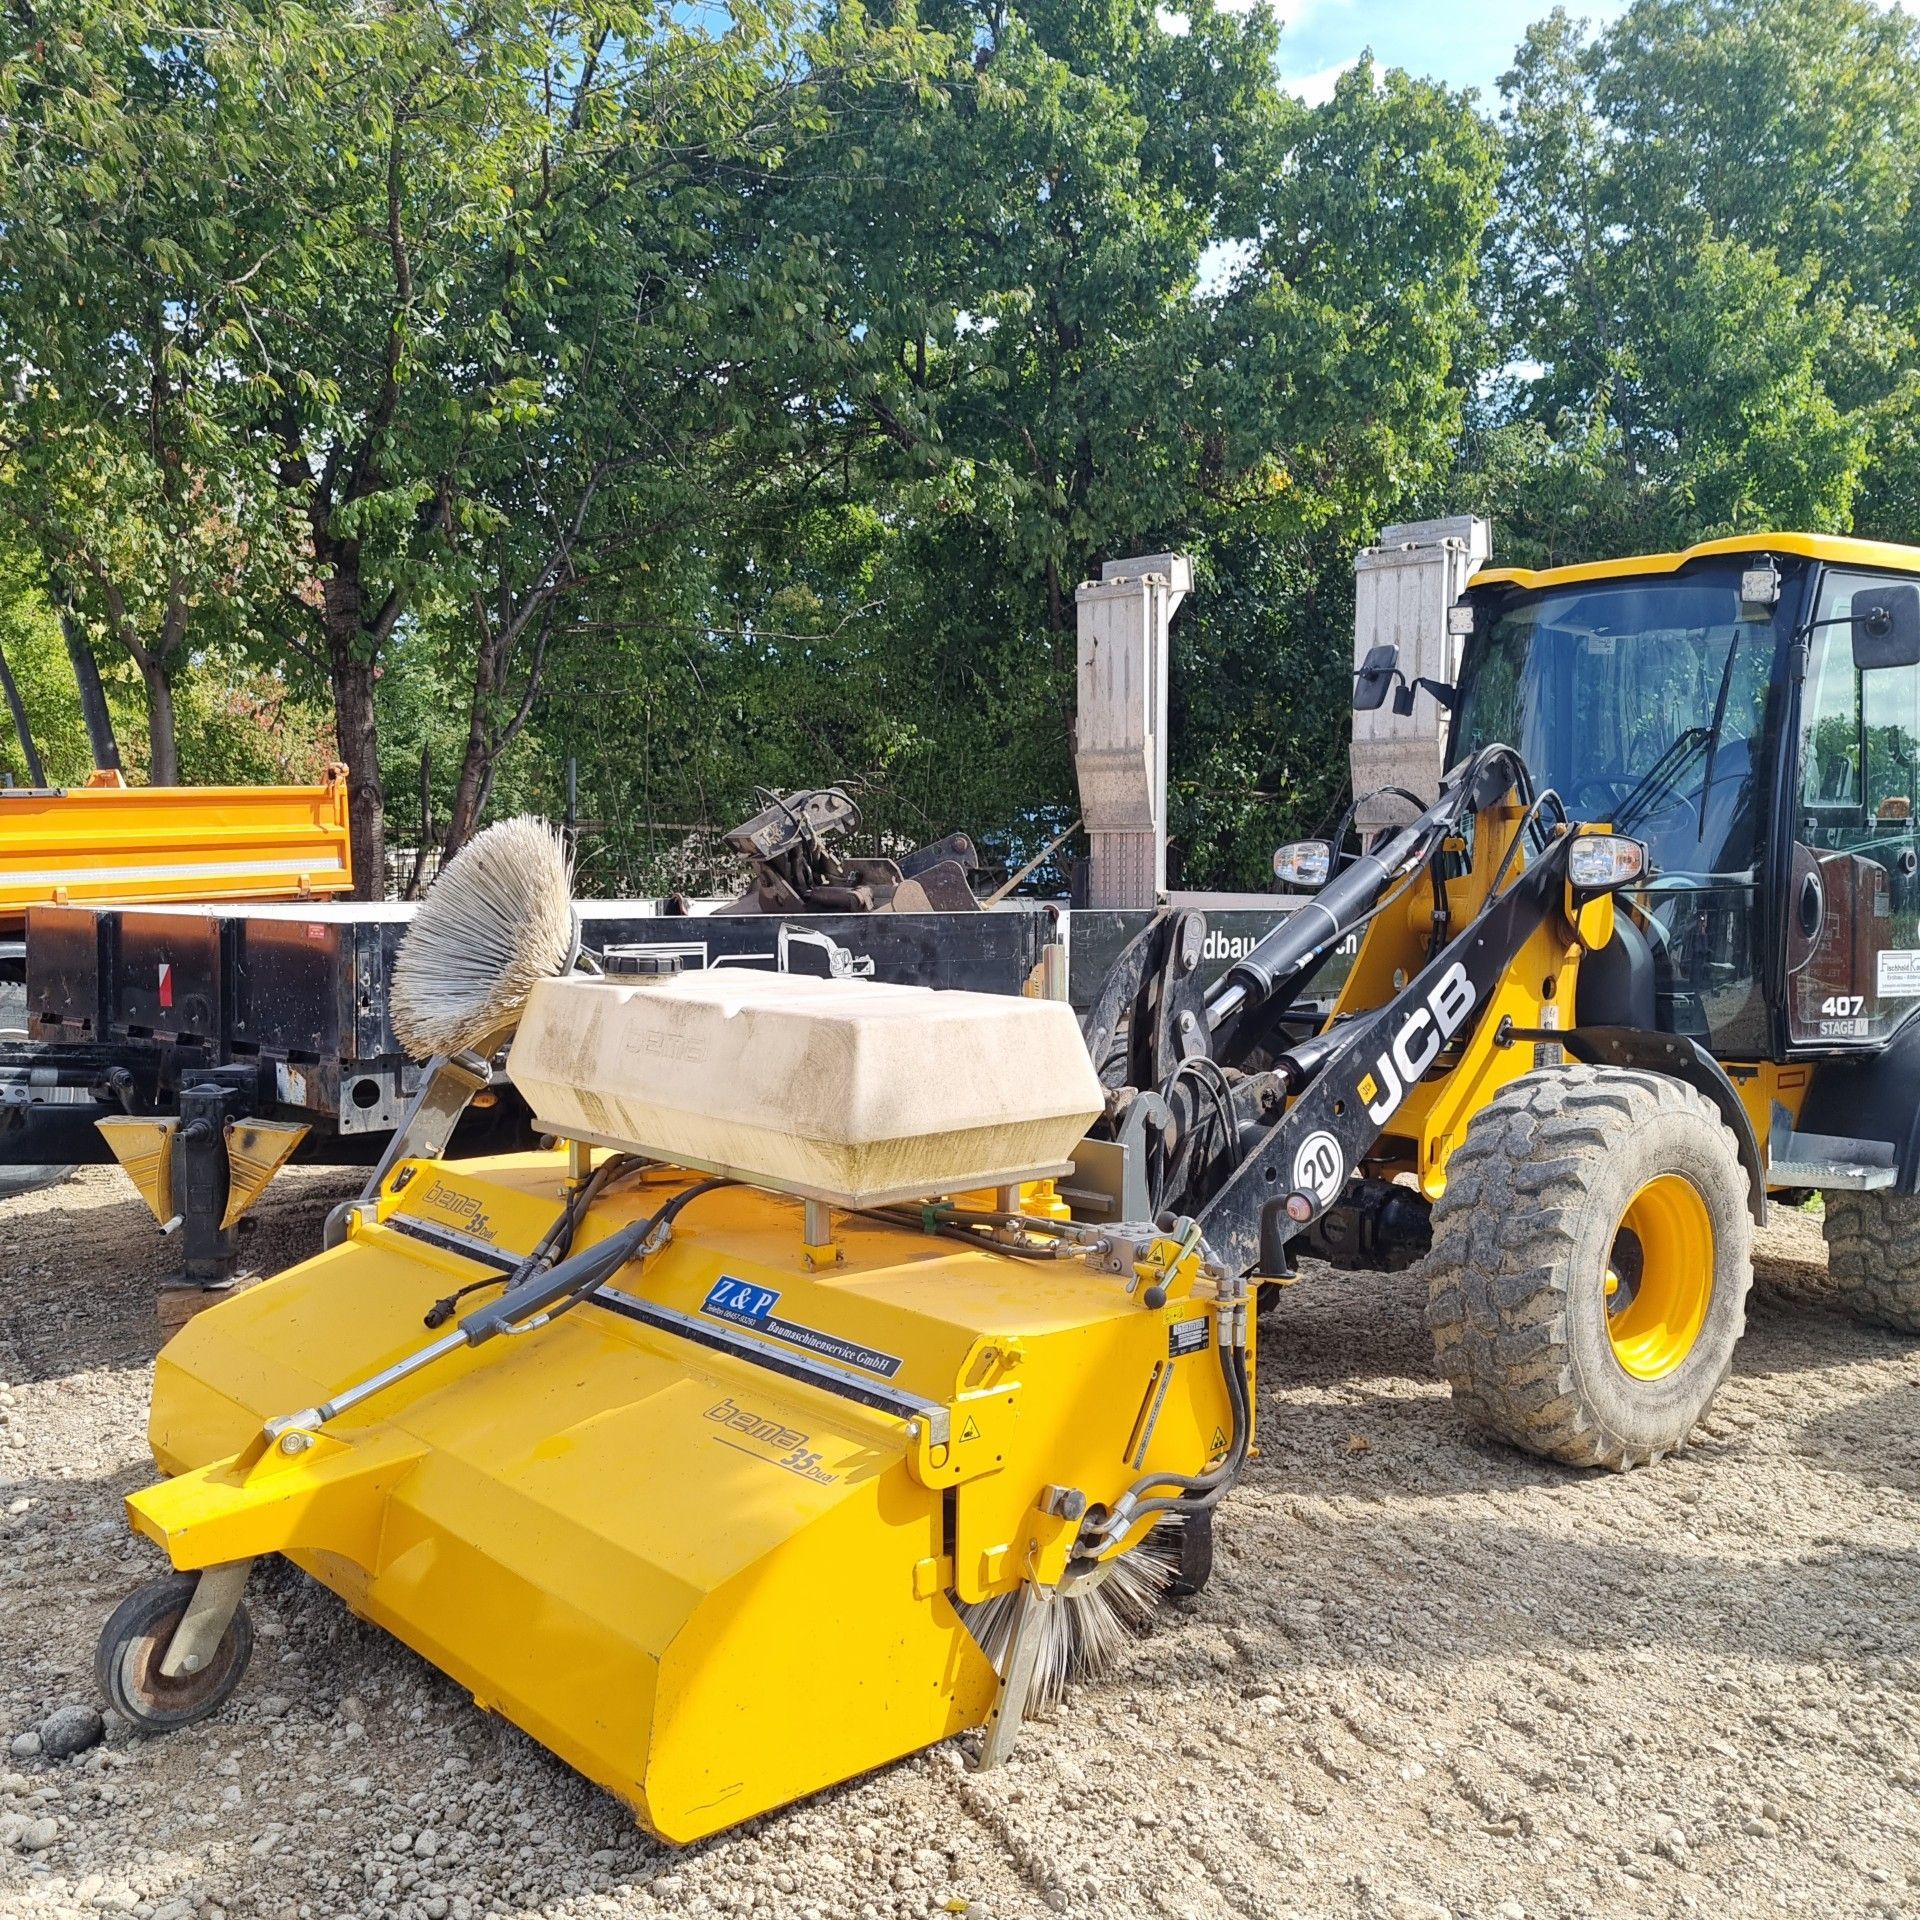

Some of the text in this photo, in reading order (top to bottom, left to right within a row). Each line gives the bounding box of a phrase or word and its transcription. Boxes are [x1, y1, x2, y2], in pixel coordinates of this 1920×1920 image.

[1203, 931, 1256, 959] dbau
[1821, 996, 1864, 1017] 407
[1368, 961, 1476, 1125] JCB
[1820, 1020, 1867, 1036] STAGE V
[1303, 1144, 1336, 1190] 20
[422, 1180, 483, 1218] bema
[465, 1213, 498, 1240] 35 Dual
[710, 1279, 773, 1316] Z & P
[766, 1321, 890, 1371] Baumaschinenservice GmbH
[703, 1398, 810, 1451] bema
[780, 1448, 839, 1483] 35 Dual
